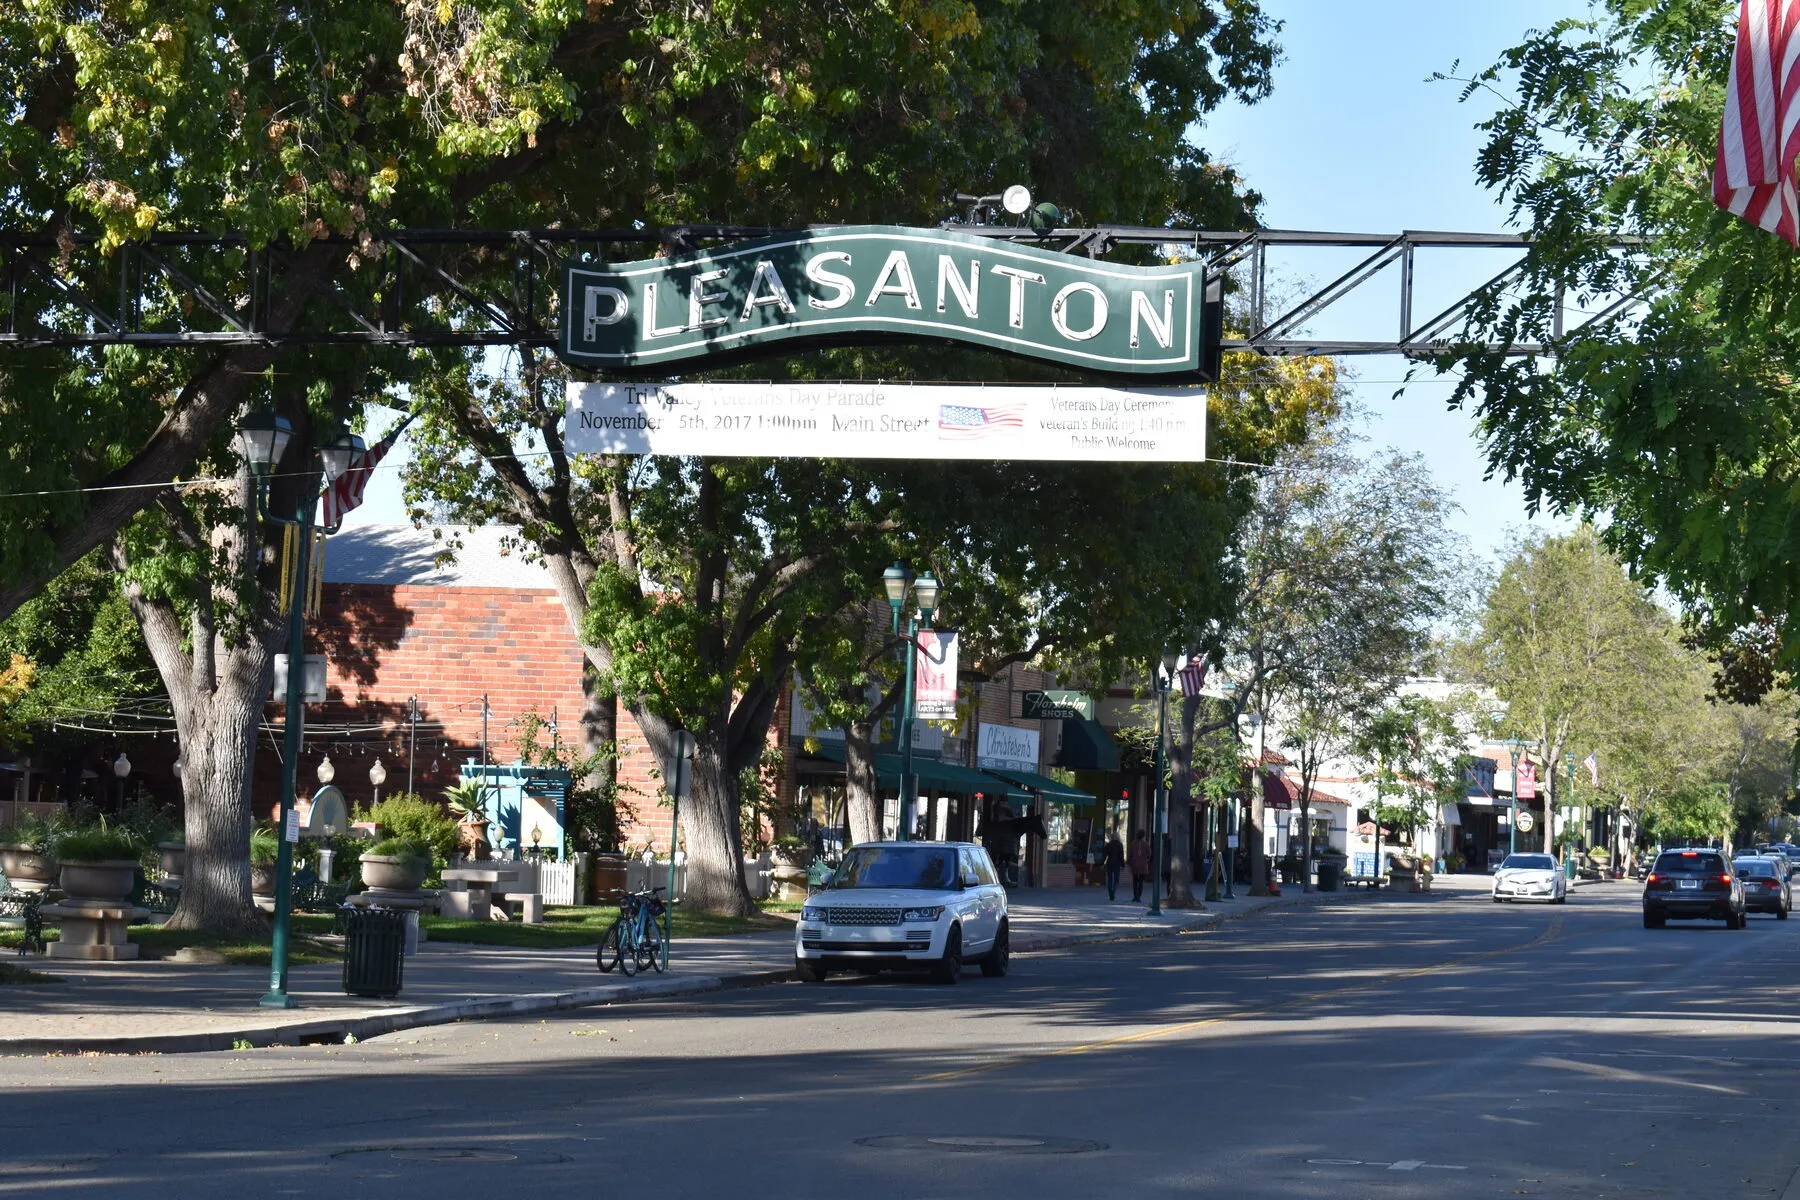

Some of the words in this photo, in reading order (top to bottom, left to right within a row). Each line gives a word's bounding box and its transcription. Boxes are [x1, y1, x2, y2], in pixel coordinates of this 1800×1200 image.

[583, 250, 1174, 348] PLEASANTON
[624, 386, 648, 405] Tri
[653, 386, 701, 410] Valley
[712, 387, 783, 406] Veterans
[790, 387, 820, 411] Day
[828, 388, 885, 406] Parade
[1051, 397, 1097, 412] Veterans
[1100, 397, 1120, 415] Day
[1124, 397, 1176, 412] Ceremon
[580, 411, 664, 431] November
[679, 414, 708, 431] 5th,
[714, 415, 752, 430] 2017
[757, 414, 818, 431] 1:00pm
[832, 414, 874, 432] Main
[880, 414, 930, 433] Street
[1040, 416, 1087, 430] Veteran's
[1091, 416, 1134, 434] Buildng
[1071, 435, 1103, 449] Public
[1107, 436, 1156, 450] Welcome
[1026, 691, 1087, 714] Florsheim
[1041, 709, 1074, 718] SHOES
